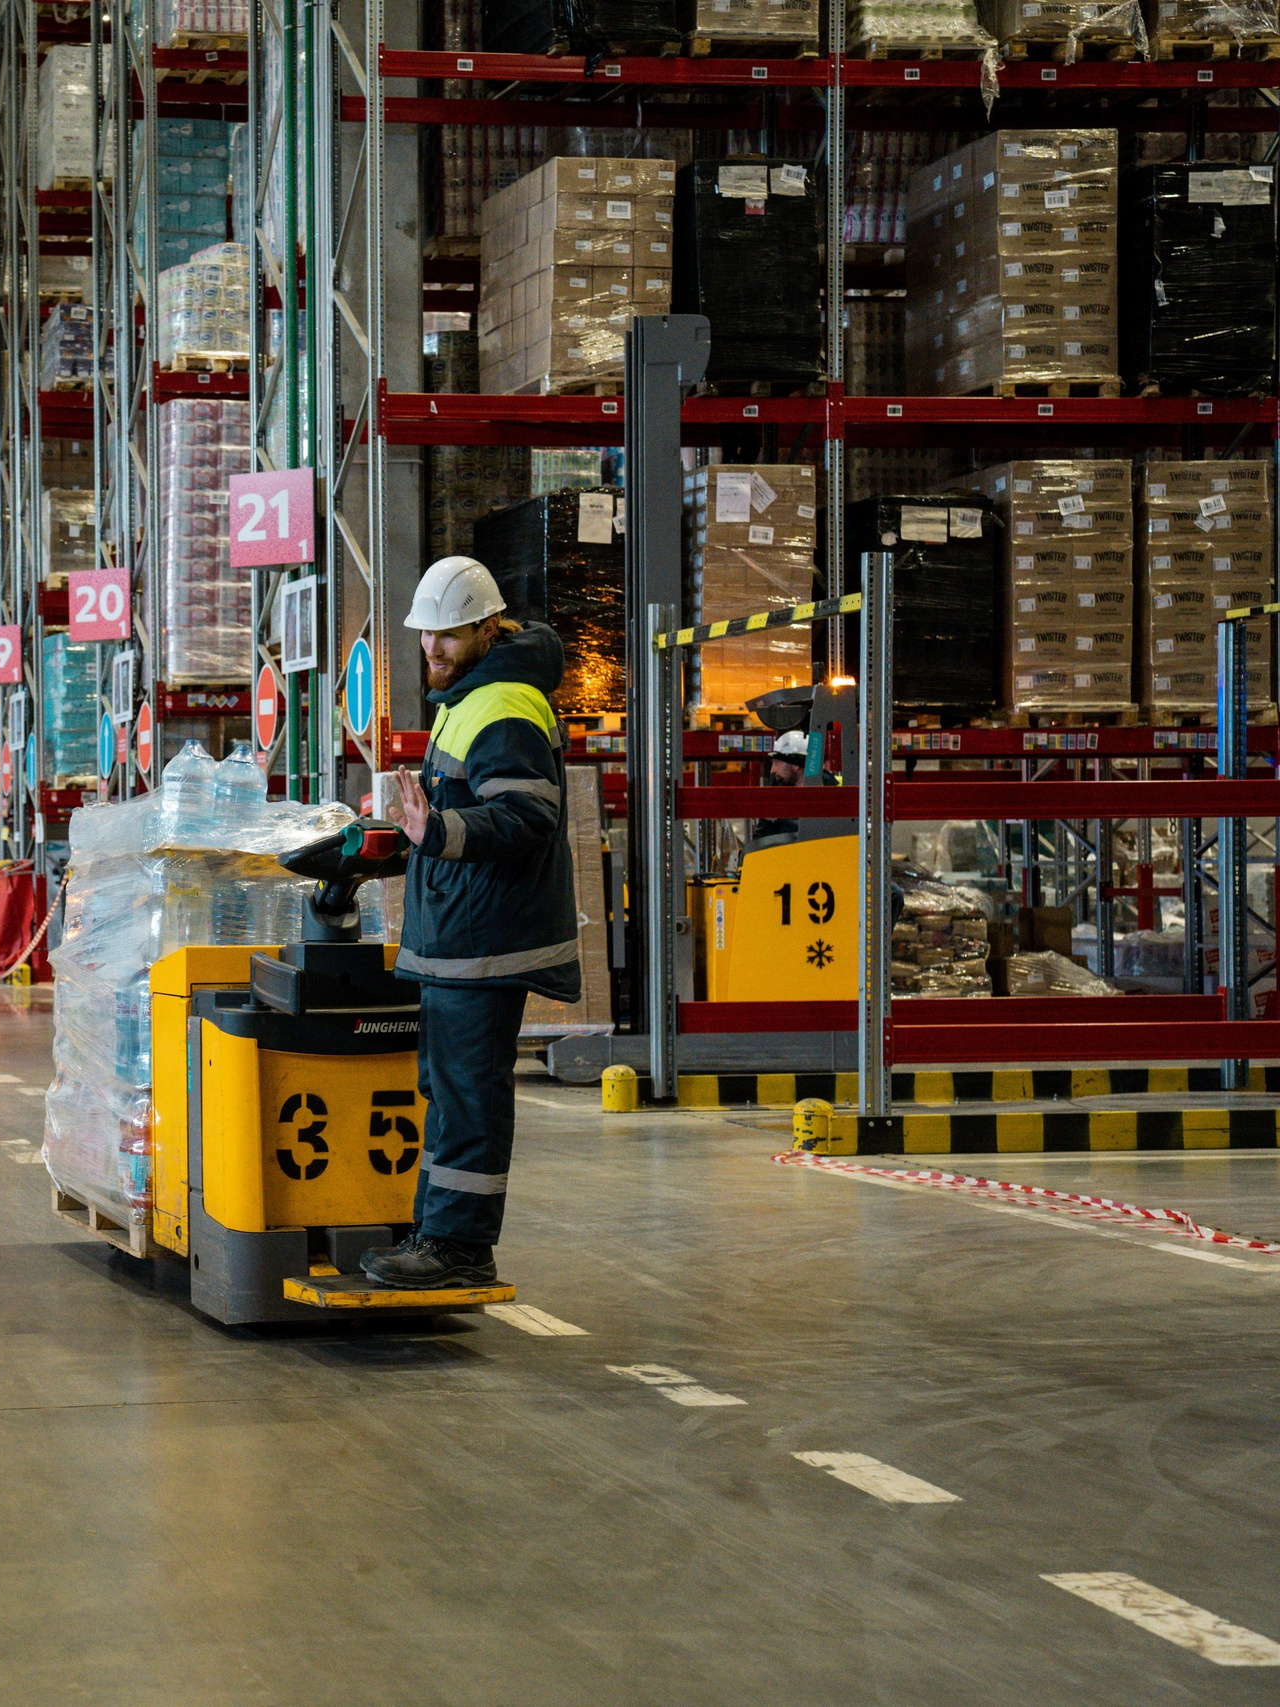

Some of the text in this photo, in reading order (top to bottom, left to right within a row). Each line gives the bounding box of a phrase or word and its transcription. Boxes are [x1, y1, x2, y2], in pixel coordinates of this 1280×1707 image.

[1022, 221, 1053, 234] TWISTER
[1024, 262, 1054, 274] TWISTER
[1079, 262, 1110, 274] TWISTER
[1024, 304, 1055, 315] TWISTER
[1080, 304, 1110, 315] TWISTER
[1026, 344, 1055, 356] TWISTER
[1081, 344, 1110, 356] TWISTER
[1094, 468, 1125, 480] TWISTER
[1169, 469, 1201, 481] TWISTER
[1228, 468, 1259, 480] TWISTER
[237, 489, 289, 542] 21
[1094, 511, 1125, 522] TWISTER
[1231, 510, 1262, 522] TWISTER
[298, 539, 308, 560] 1
[1035, 551, 1066, 563] TWISTER
[1094, 551, 1125, 563] TWISTER
[1173, 551, 1205, 563] TWISTER
[1231, 550, 1262, 563] TWISTER
[75, 583, 124, 623] 20
[1036, 591, 1068, 604] TWISTER
[1094, 591, 1125, 604] TWISTER
[1174, 591, 1205, 604] TWISTER
[1232, 591, 1262, 603] TWISTER
[119, 620, 126, 638] 1
[1036, 632, 1068, 644] TWISTER
[1094, 632, 1124, 644] TWISTER
[1174, 632, 1206, 644] TWISTER
[12, 668, 18, 681] 1
[1036, 672, 1067, 684] TWISTER
[1093, 672, 1124, 684] TWISTER
[1174, 672, 1205, 685] TWISTER
[773, 881, 835, 925] 19
[276, 1090, 419, 1180] 35
